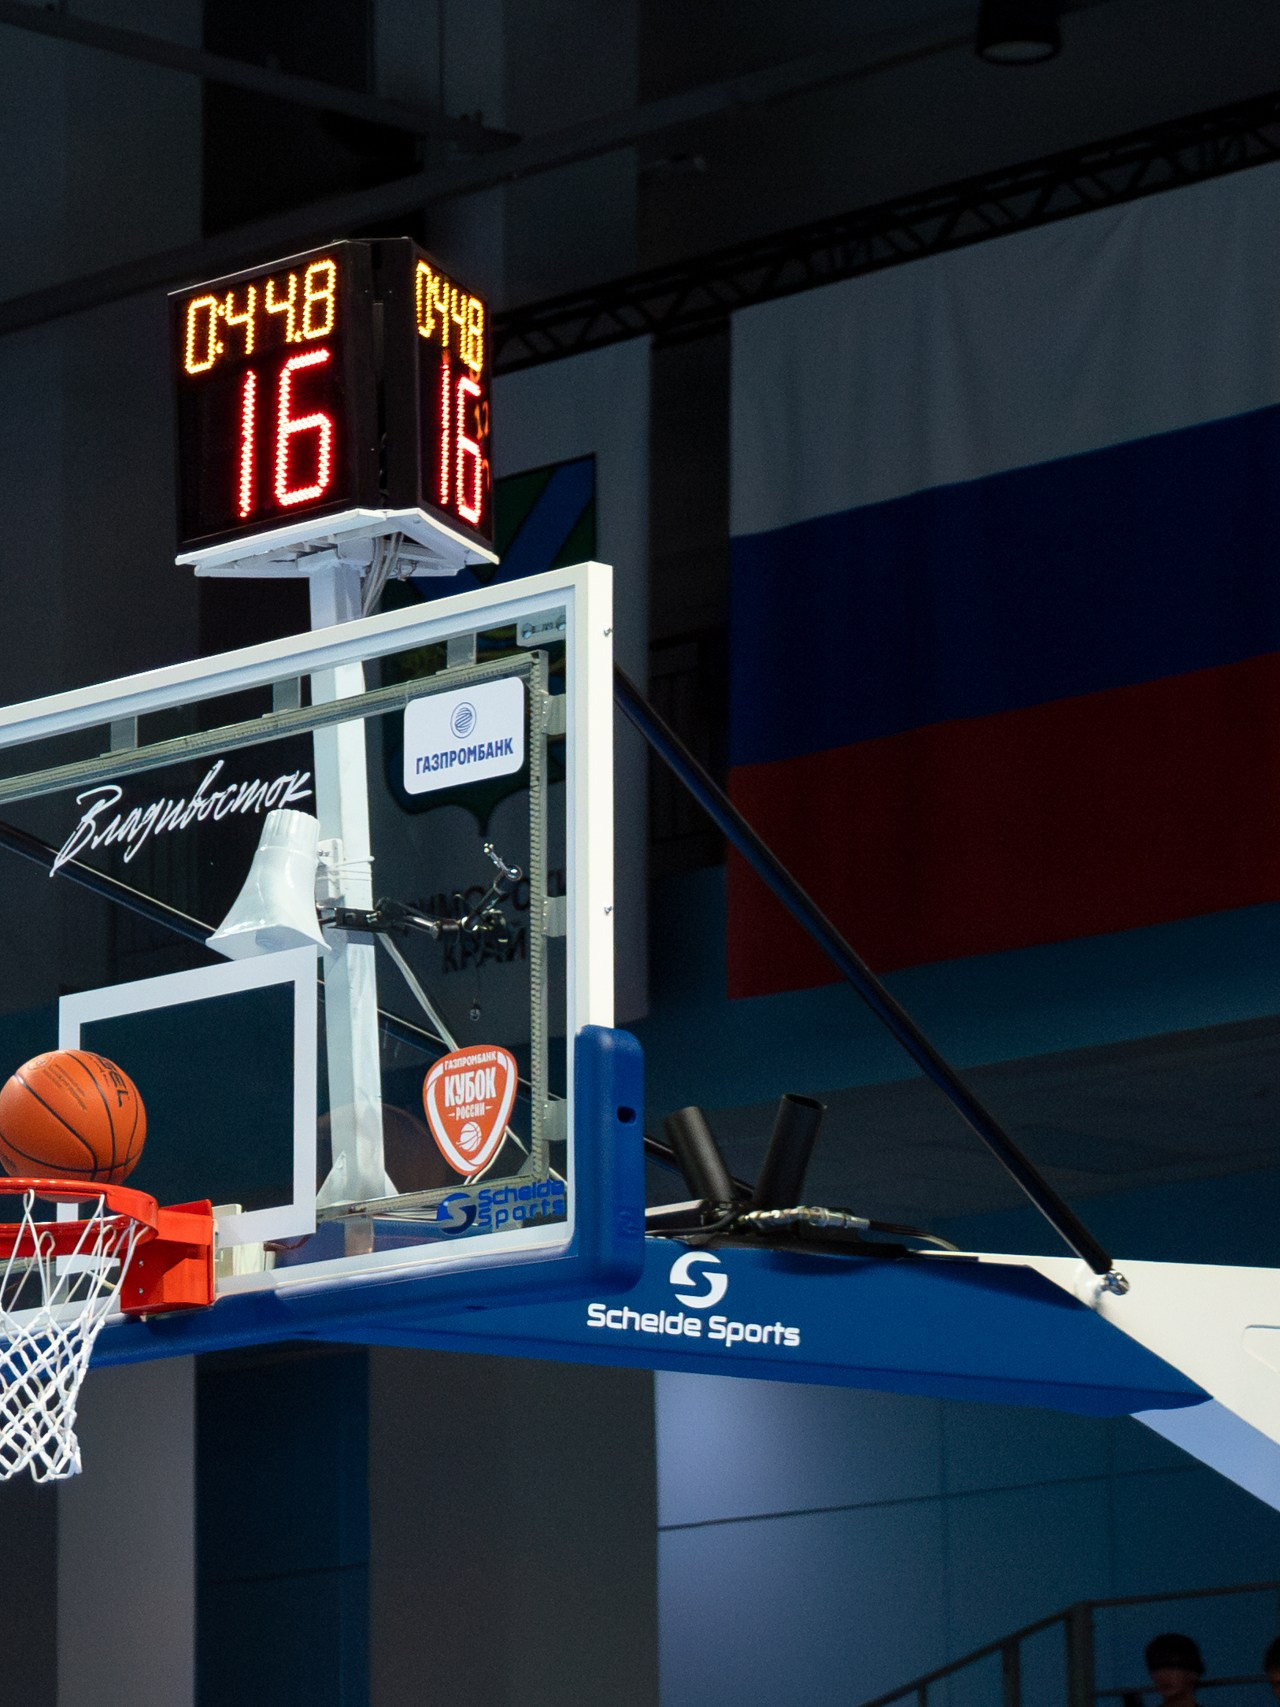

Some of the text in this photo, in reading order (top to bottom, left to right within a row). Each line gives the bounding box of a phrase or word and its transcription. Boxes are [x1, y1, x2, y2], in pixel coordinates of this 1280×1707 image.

[236, 348, 334, 519] 16
[439, 364, 483, 525] 16
[415, 737, 514, 775] ГАЗПРОМБАНК
[48, 760, 313, 878] Владивосток
[443, 1050, 498, 1070] ГАЗПРОМБАНК
[443, 1066, 497, 1108] КУБОК
[455, 1102, 485, 1121] РОССИИ
[478, 1178, 566, 1208] Schelde
[478, 1199, 566, 1230] Sports
[586, 1303, 801, 1348] Schelde Sports
